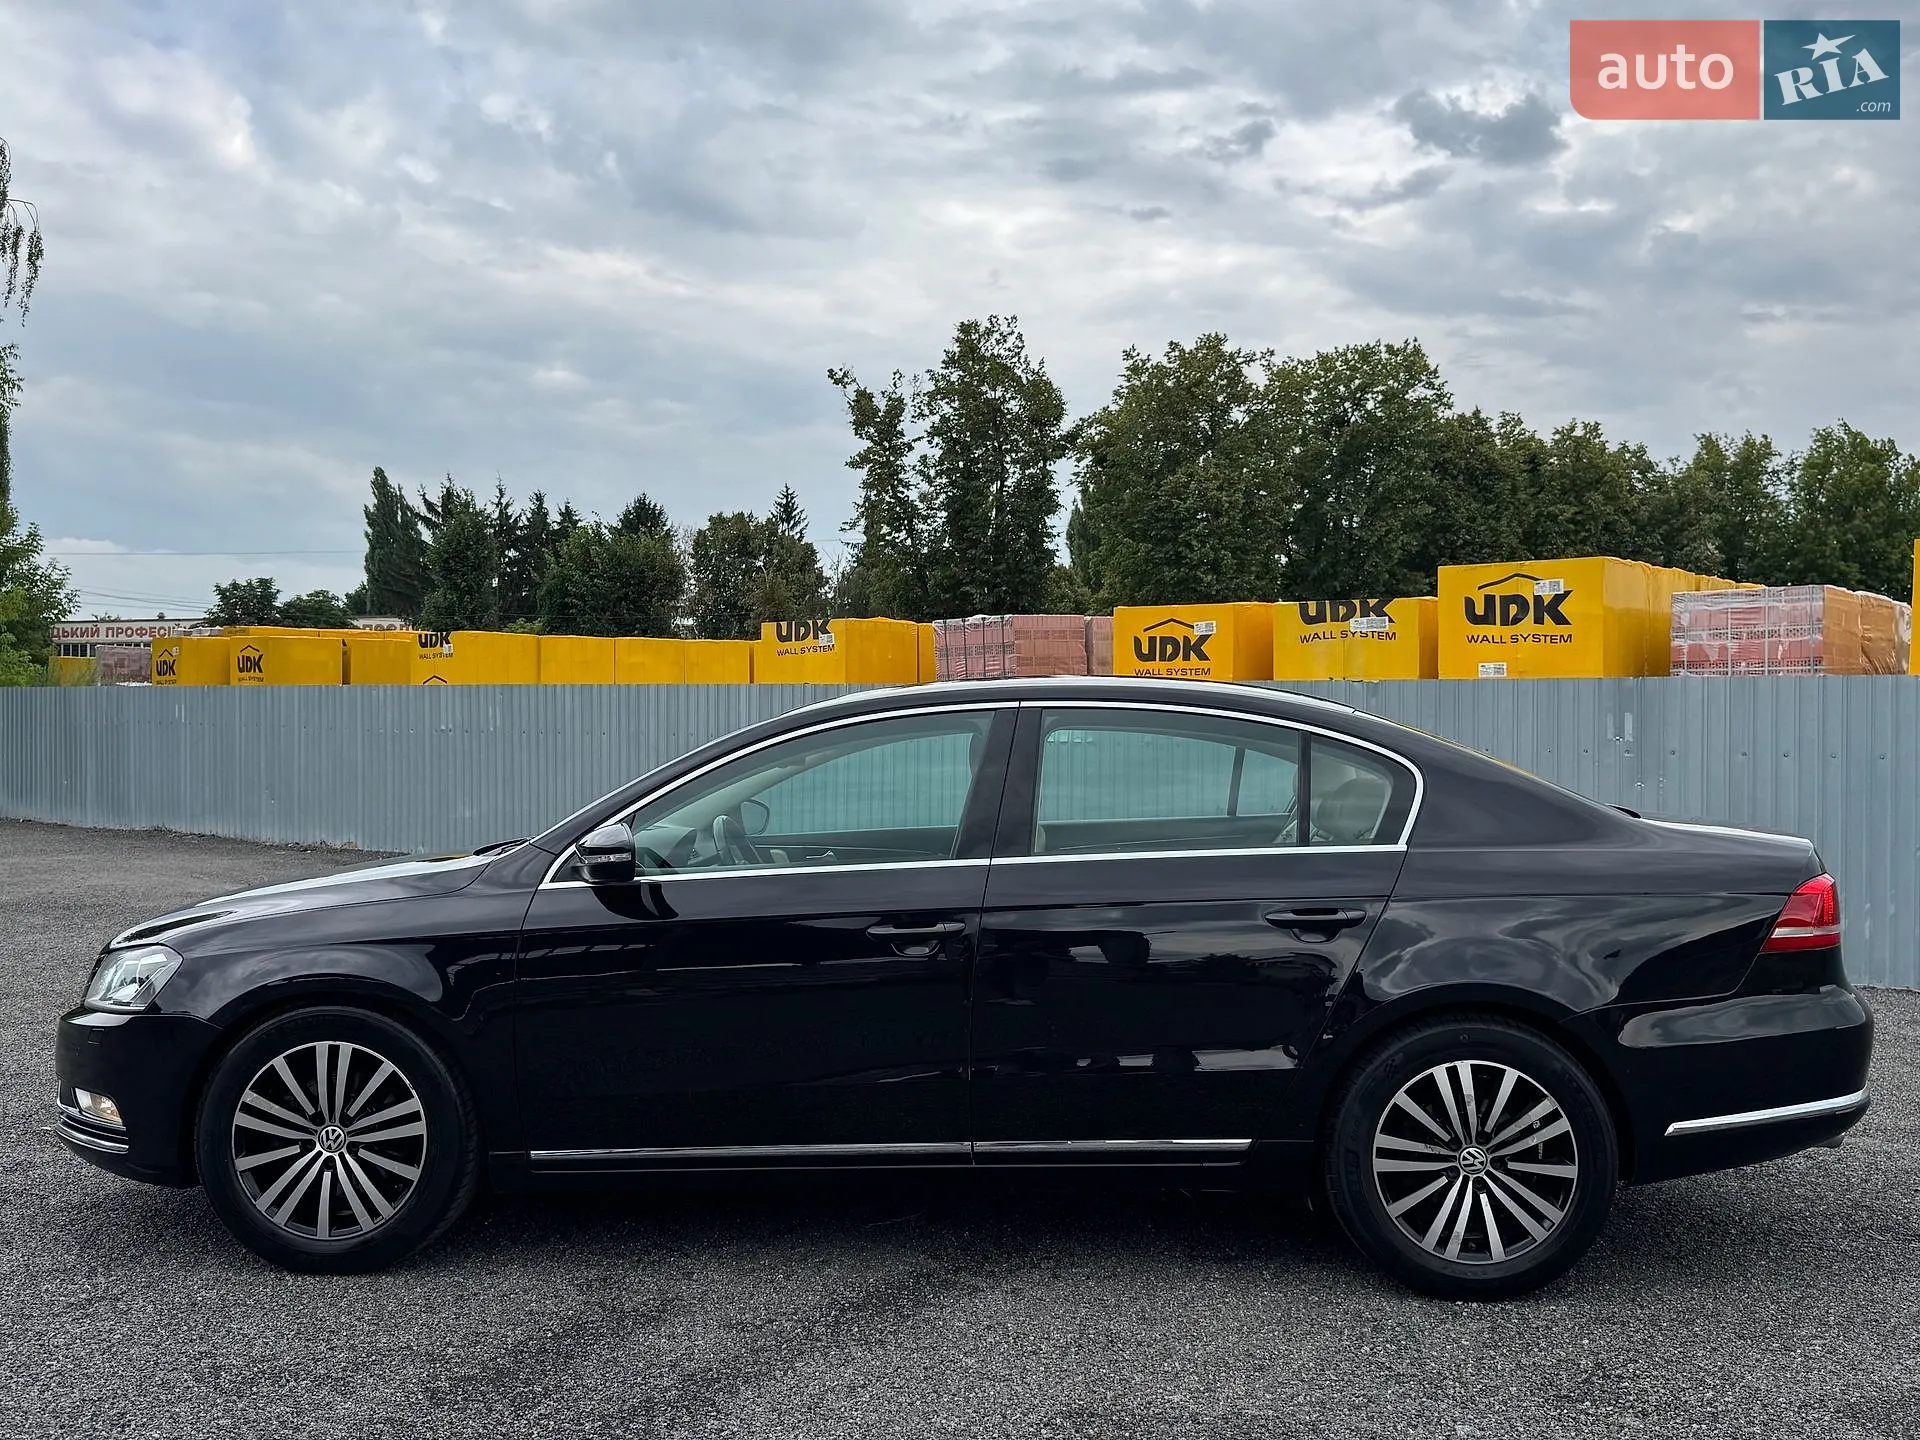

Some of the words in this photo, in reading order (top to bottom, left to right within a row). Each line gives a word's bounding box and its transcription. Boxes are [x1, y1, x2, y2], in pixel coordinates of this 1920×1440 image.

[1299, 599, 1396, 625] UDK
[1464, 590, 1574, 626] UDK
[776, 619, 832, 642] UDK
[1300, 630, 1337, 644] WALL
[1340, 629, 1397, 641] SYSTEM
[1466, 634, 1507, 644] WALL
[1510, 633, 1573, 644] SYSTEM
[418, 631, 452, 648] UDK
[1133, 634, 1212, 662] UDK
[776, 647, 799, 656] WALL
[800, 644, 835, 655] SYSTEM
[156, 659, 176, 676] UDK
[237, 654, 264, 673] UDK
[1134, 668, 1162, 676] WALL
[1166, 667, 1211, 676] SYSTEM
